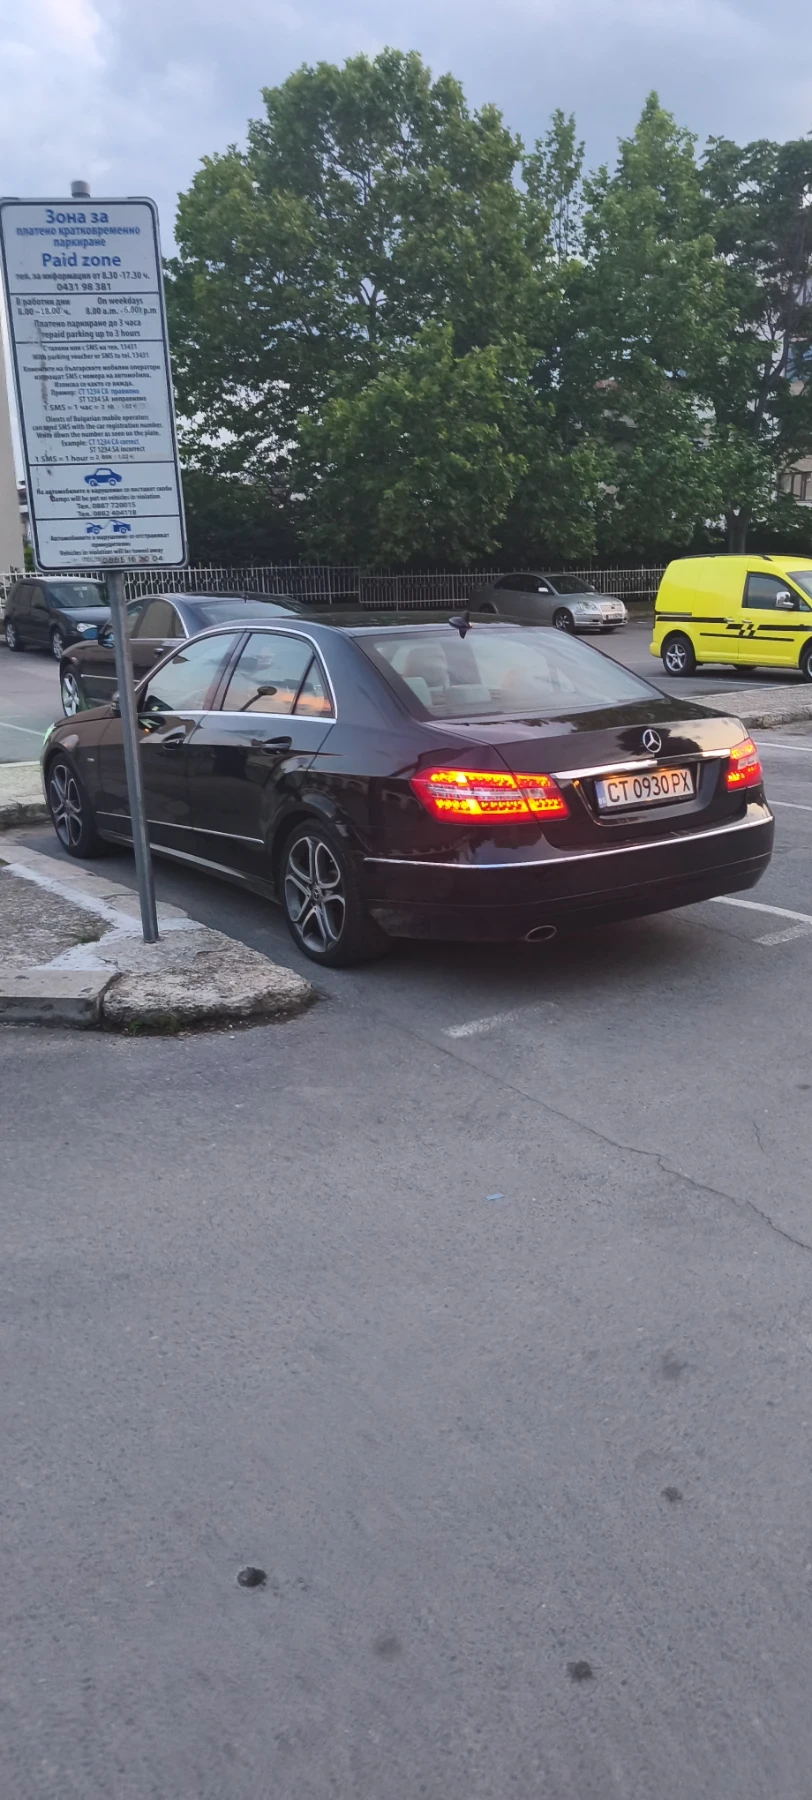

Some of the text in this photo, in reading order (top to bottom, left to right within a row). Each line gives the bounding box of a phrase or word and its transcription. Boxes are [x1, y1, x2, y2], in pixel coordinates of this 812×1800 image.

[45, 208, 109, 224] Зона за
[16, 226, 141, 237] платено кратковременно
[53, 238, 106, 249] паркиране
[42, 252, 121, 267] Paid zone
[42, 272, 91, 281] информация
[102, 271, 118, 280] 8.30
[143, 272, 151, 280] ч.
[57, 282, 112, 291] 0431 98 381
[22, 297, 54, 307] работни
[97, 296, 144, 306] On weekdays
[85, 307, 102, 315] 8.00
[34, 318, 142, 329] Платено паркиране до 3 часа
[38, 328, 141, 340] repaid parking up to 3 hours
[86, 343, 99, 351] SMS
[47, 353, 71, 361] parking
[132, 351, 149, 359] 13431
[58, 423, 71, 431] SMS
[97, 438, 111, 446] 1234
[89, 446, 96, 454] ST
[71, 454, 89, 462] hour
[607, 771, 690, 803] CT 0930 PX
